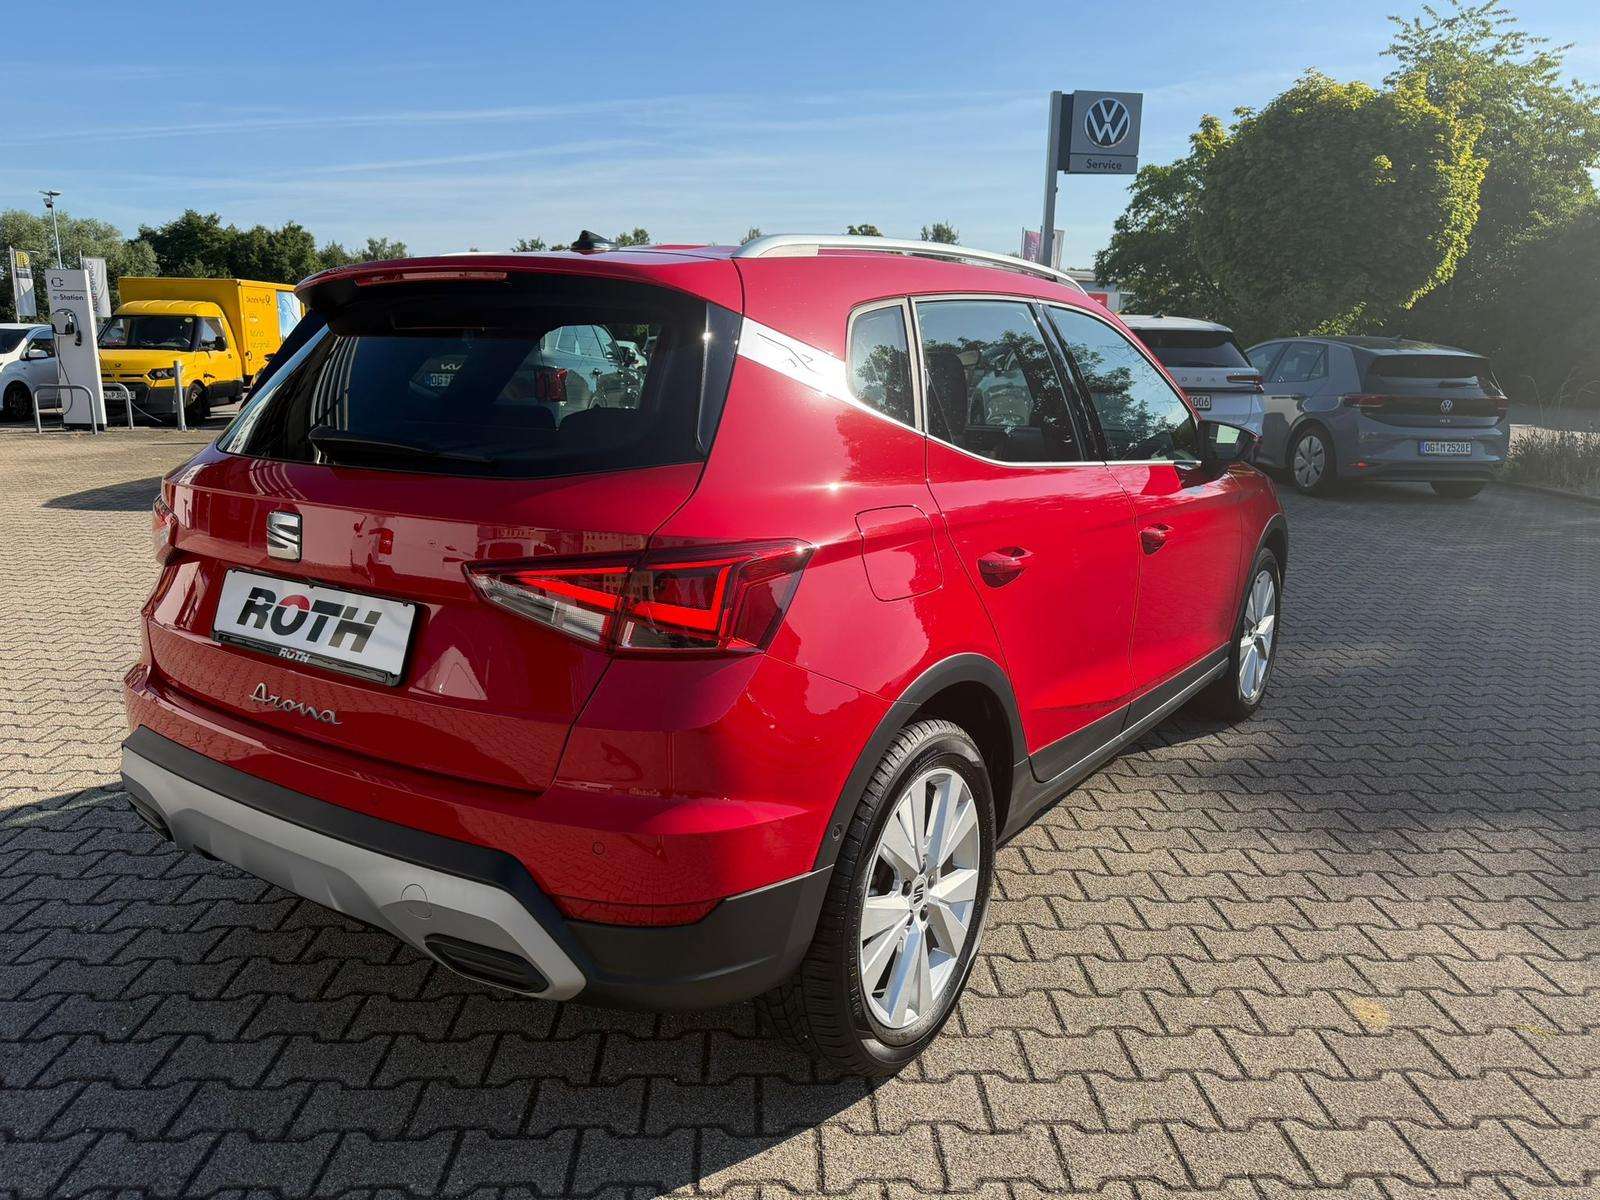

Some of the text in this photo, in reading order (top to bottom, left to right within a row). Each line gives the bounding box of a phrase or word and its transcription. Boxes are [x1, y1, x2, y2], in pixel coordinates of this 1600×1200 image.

[1086, 159, 1122, 170] Service
[237, 587, 383, 653] ROTH
[279, 647, 310, 662] ROTH
[249, 682, 344, 725] Arona
